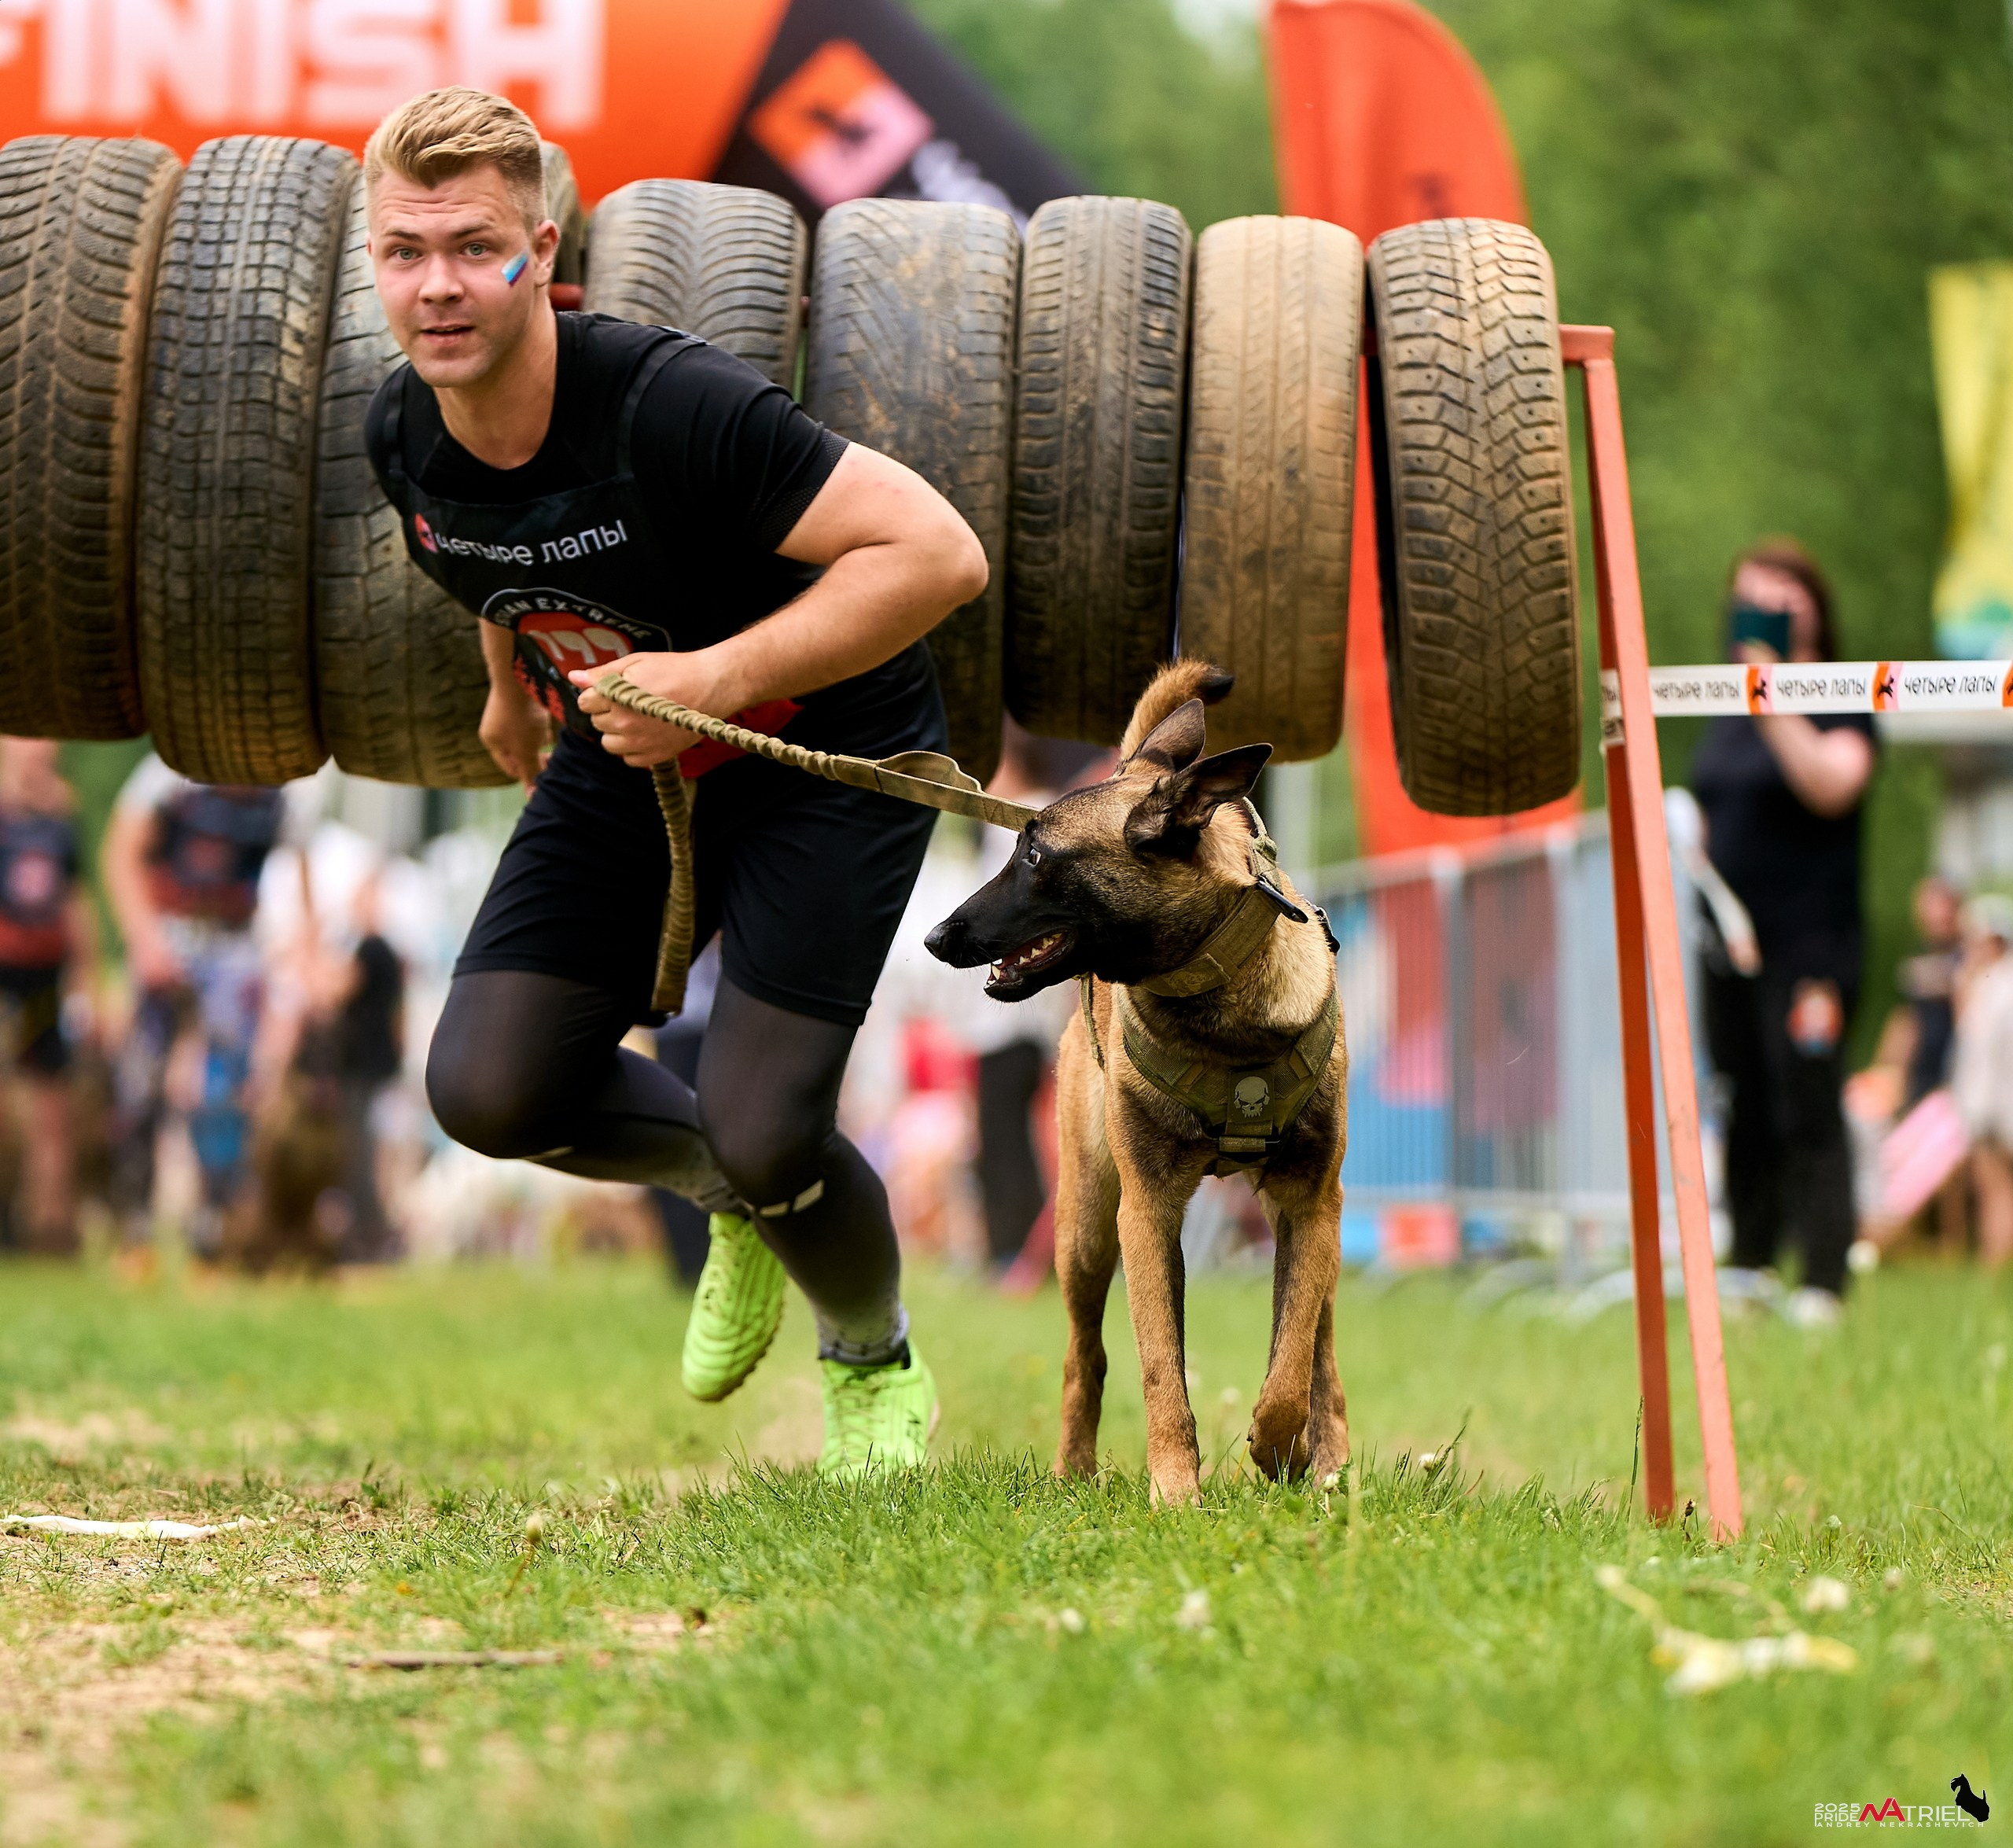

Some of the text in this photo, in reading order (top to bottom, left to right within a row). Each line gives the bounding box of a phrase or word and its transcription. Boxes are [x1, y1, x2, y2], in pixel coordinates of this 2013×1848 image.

[435, 519, 628, 566] четыре лапы
[1904, 675, 1997, 694] четыре лапы
